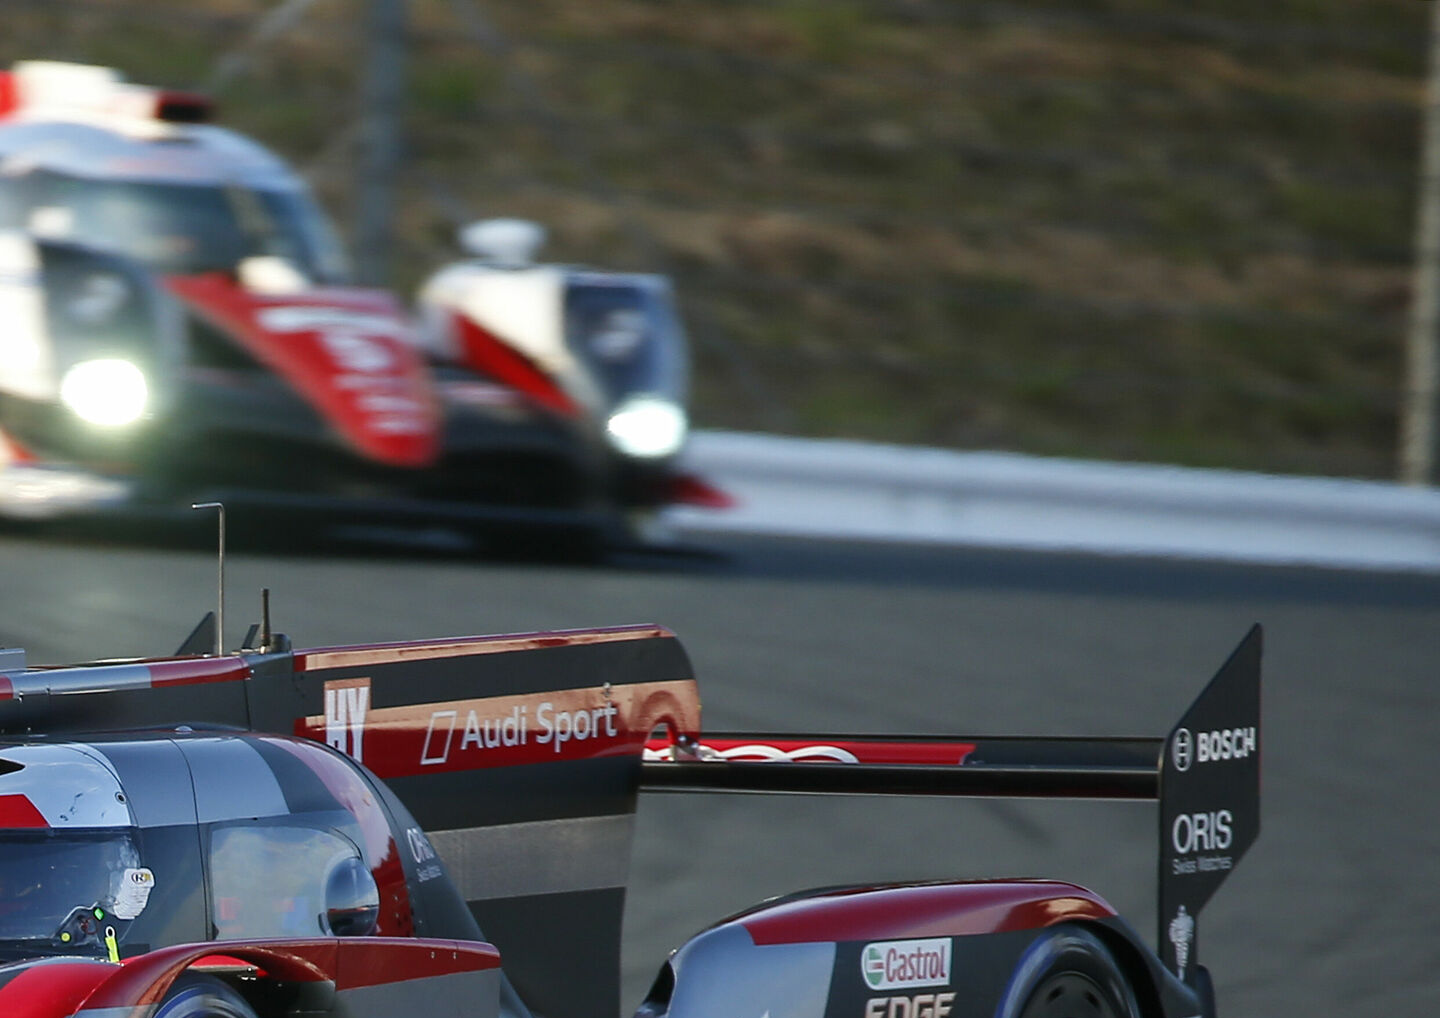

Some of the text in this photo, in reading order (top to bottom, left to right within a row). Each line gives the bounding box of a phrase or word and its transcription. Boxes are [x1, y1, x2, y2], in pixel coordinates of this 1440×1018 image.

[326, 686, 370, 764] HY
[460, 701, 618, 753] Audi Sport
[1197, 727, 1256, 763] BOSCH
[1172, 810, 1233, 853] ORIS
[885, 945, 948, 983] Castrol
